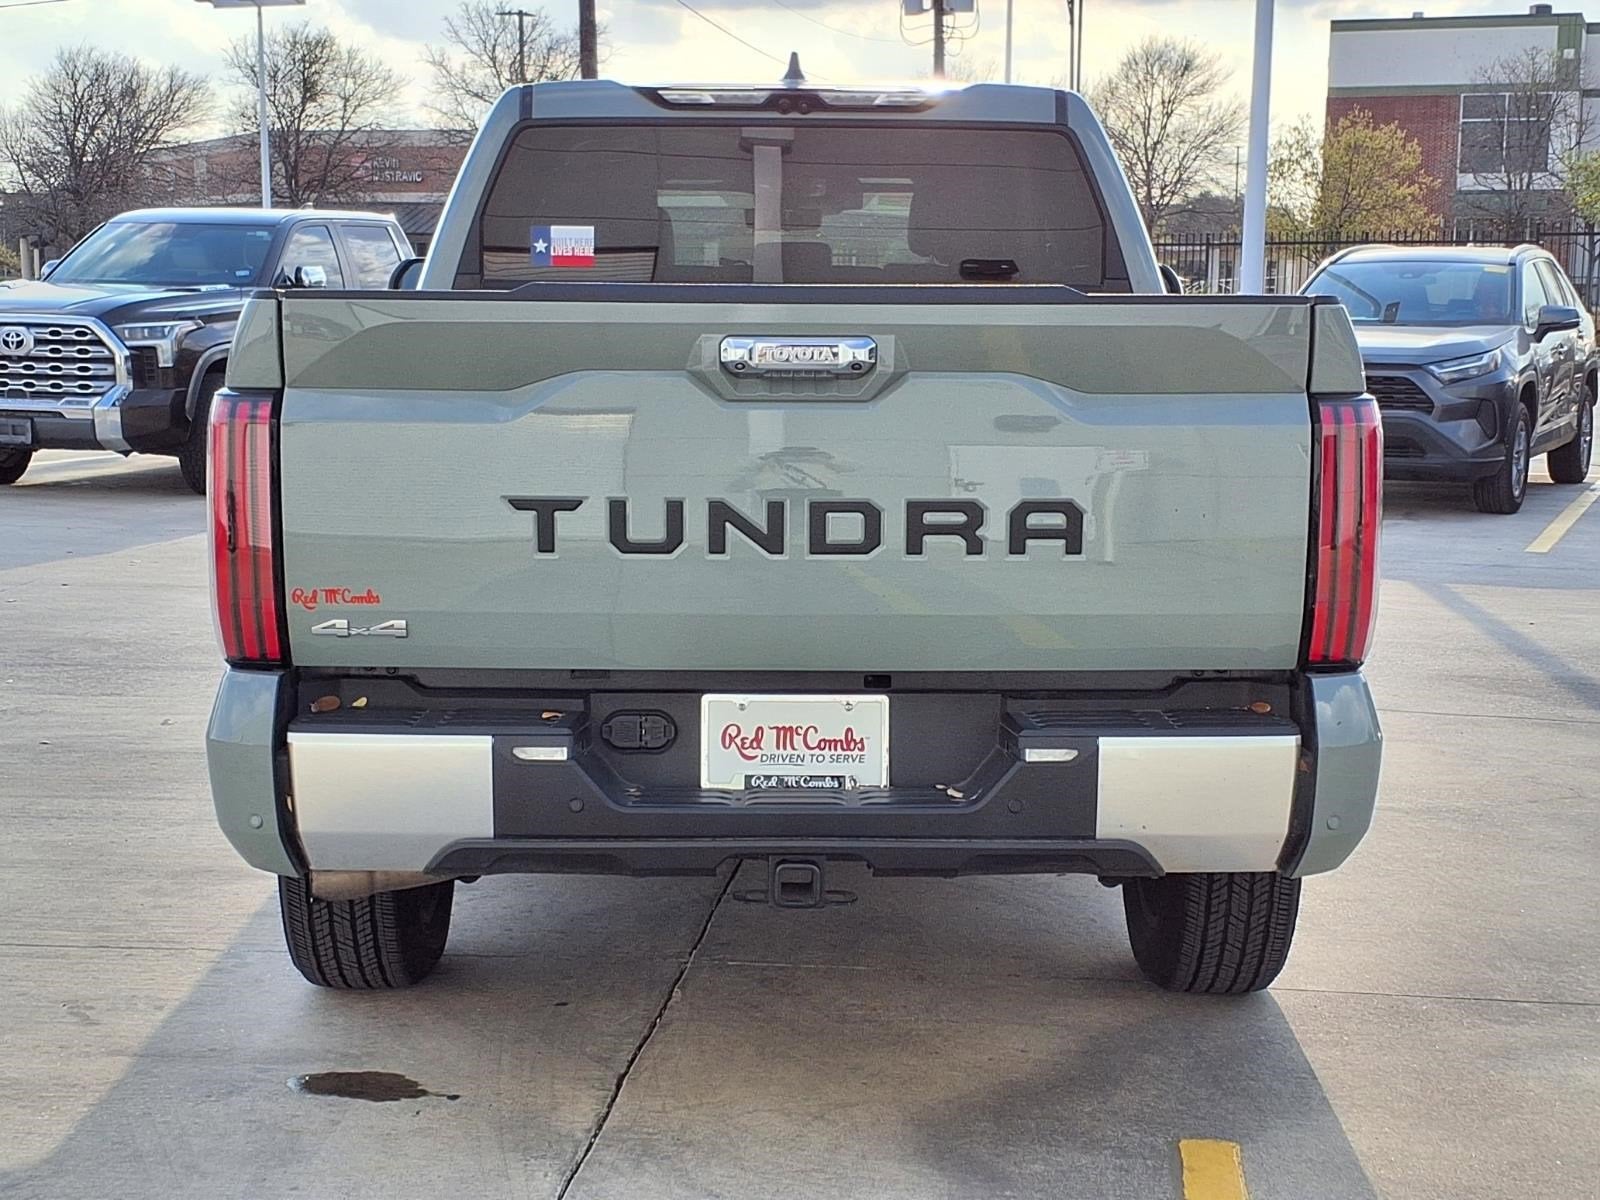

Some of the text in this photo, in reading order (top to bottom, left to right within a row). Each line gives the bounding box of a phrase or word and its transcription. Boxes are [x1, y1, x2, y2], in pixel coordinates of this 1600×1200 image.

[574, 237, 594, 247] HERE
[551, 246, 594, 256] LIVES HERE
[764, 346, 835, 362] TOYOTA
[502, 496, 1087, 558] TUNDRA
[291, 586, 381, 611] Red McCombs
[311, 619, 408, 638] 4x4
[720, 723, 866, 761] Red McCombs
[759, 753, 866, 764] DRIVEN TO SERVE
[751, 775, 840, 789] Red McCombs
